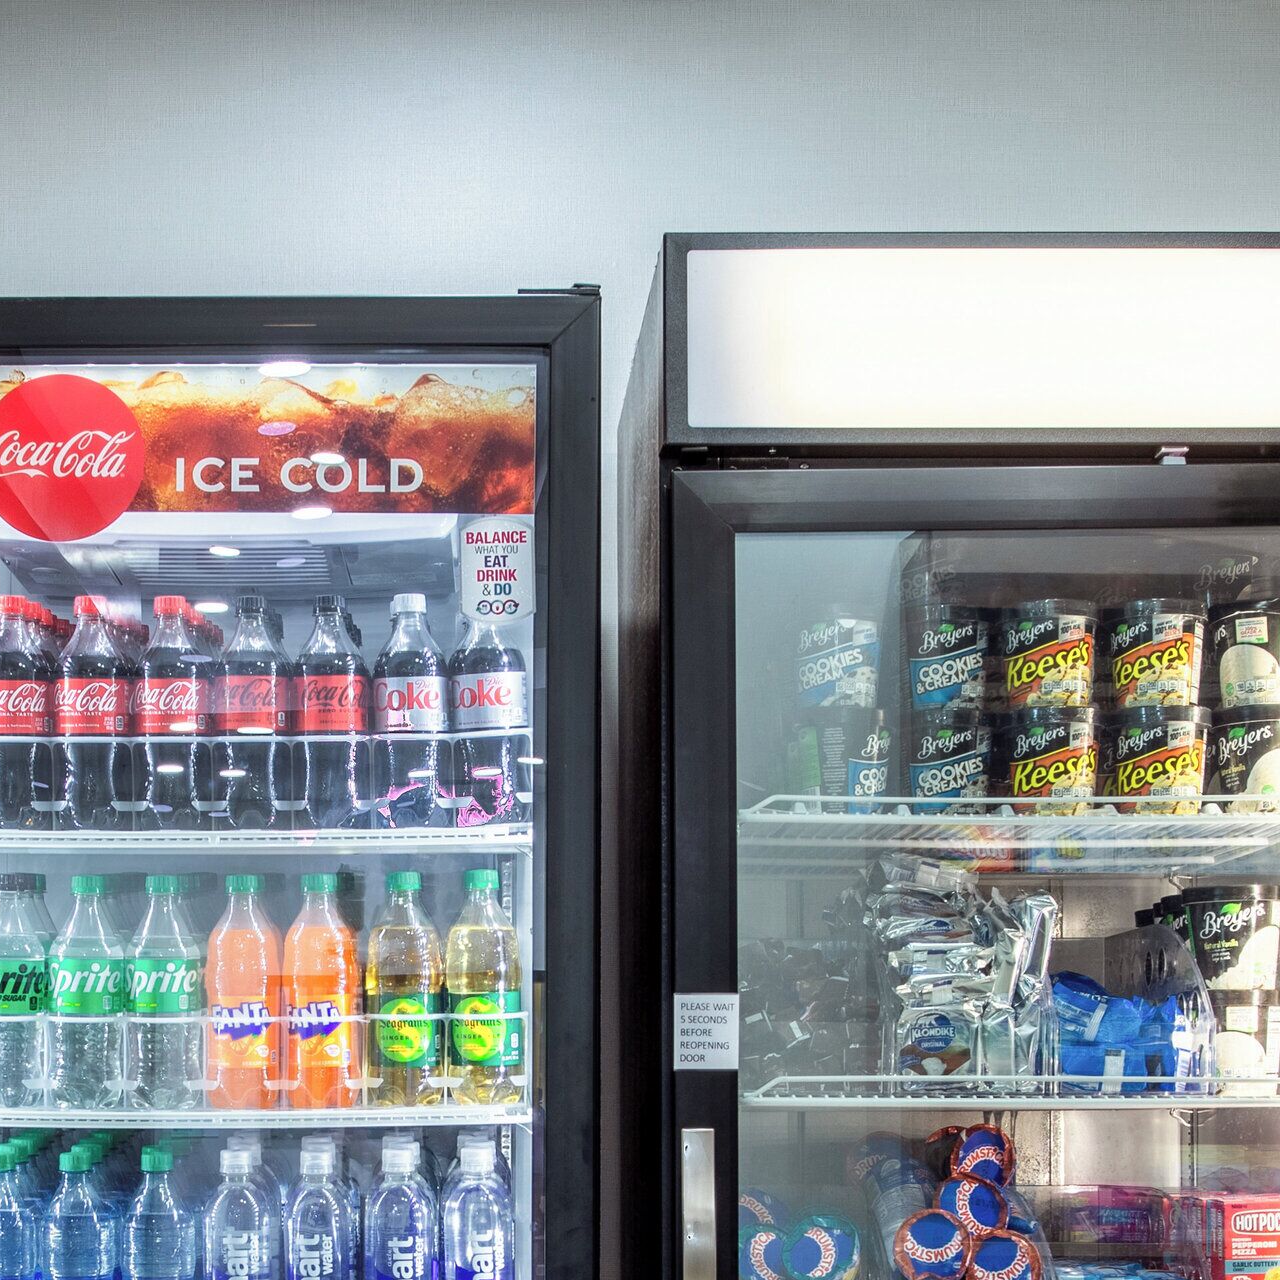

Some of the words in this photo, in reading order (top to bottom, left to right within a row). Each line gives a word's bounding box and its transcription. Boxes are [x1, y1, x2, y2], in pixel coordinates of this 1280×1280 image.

[176, 457, 260, 493] ICE
[281, 457, 425, 493] COLD
[466, 531, 527, 544] BALANCE
[475, 545, 499, 554] WHAT
[502, 545, 519, 553] YOU
[477, 569, 517, 582] DRINK
[482, 583, 491, 596] &
[494, 583, 512, 595] DO
[918, 624, 973, 655] Breyers
[1006, 619, 1054, 654] Breyers
[798, 648, 863, 681] COOKIES
[919, 652, 983, 681] COOKIES
[54, 682, 121, 712] Coca-Cola
[375, 682, 439, 712] Coke
[451, 678, 512, 709] Coke
[925, 672, 969, 692] CREAM
[129, 681, 202, 714] Coca-Cola
[917, 730, 972, 760] Breyers
[1014, 726, 1067, 759] Breyers
[1117, 726, 1163, 760] Breyers
[1217, 724, 1273, 766] Breyers
[918, 756, 984, 786] COOKIES
[1200, 902, 1266, 939] Breyers
[48, 962, 120, 998] Sprite
[125, 962, 197, 999] Sprite
[212, 1002, 270, 1029] FANTA
[680, 1003, 710, 1011] PLEASE
[713, 1003, 735, 1011] WAIT
[680, 1016, 686, 1024] 5
[688, 1016, 728, 1024] SECONDS
[680, 1028, 712, 1037] BEFORE
[680, 1041, 730, 1050] REOPENING
[911, 1027, 956, 1043] KLONDIKE
[680, 1054, 706, 1062] DOOR
[1235, 1214, 1258, 1232] HOT
[249, 1232, 260, 1274] water
[322, 1233, 333, 1276] water
[414, 1235, 425, 1278] water
[494, 1229, 504, 1270] water
